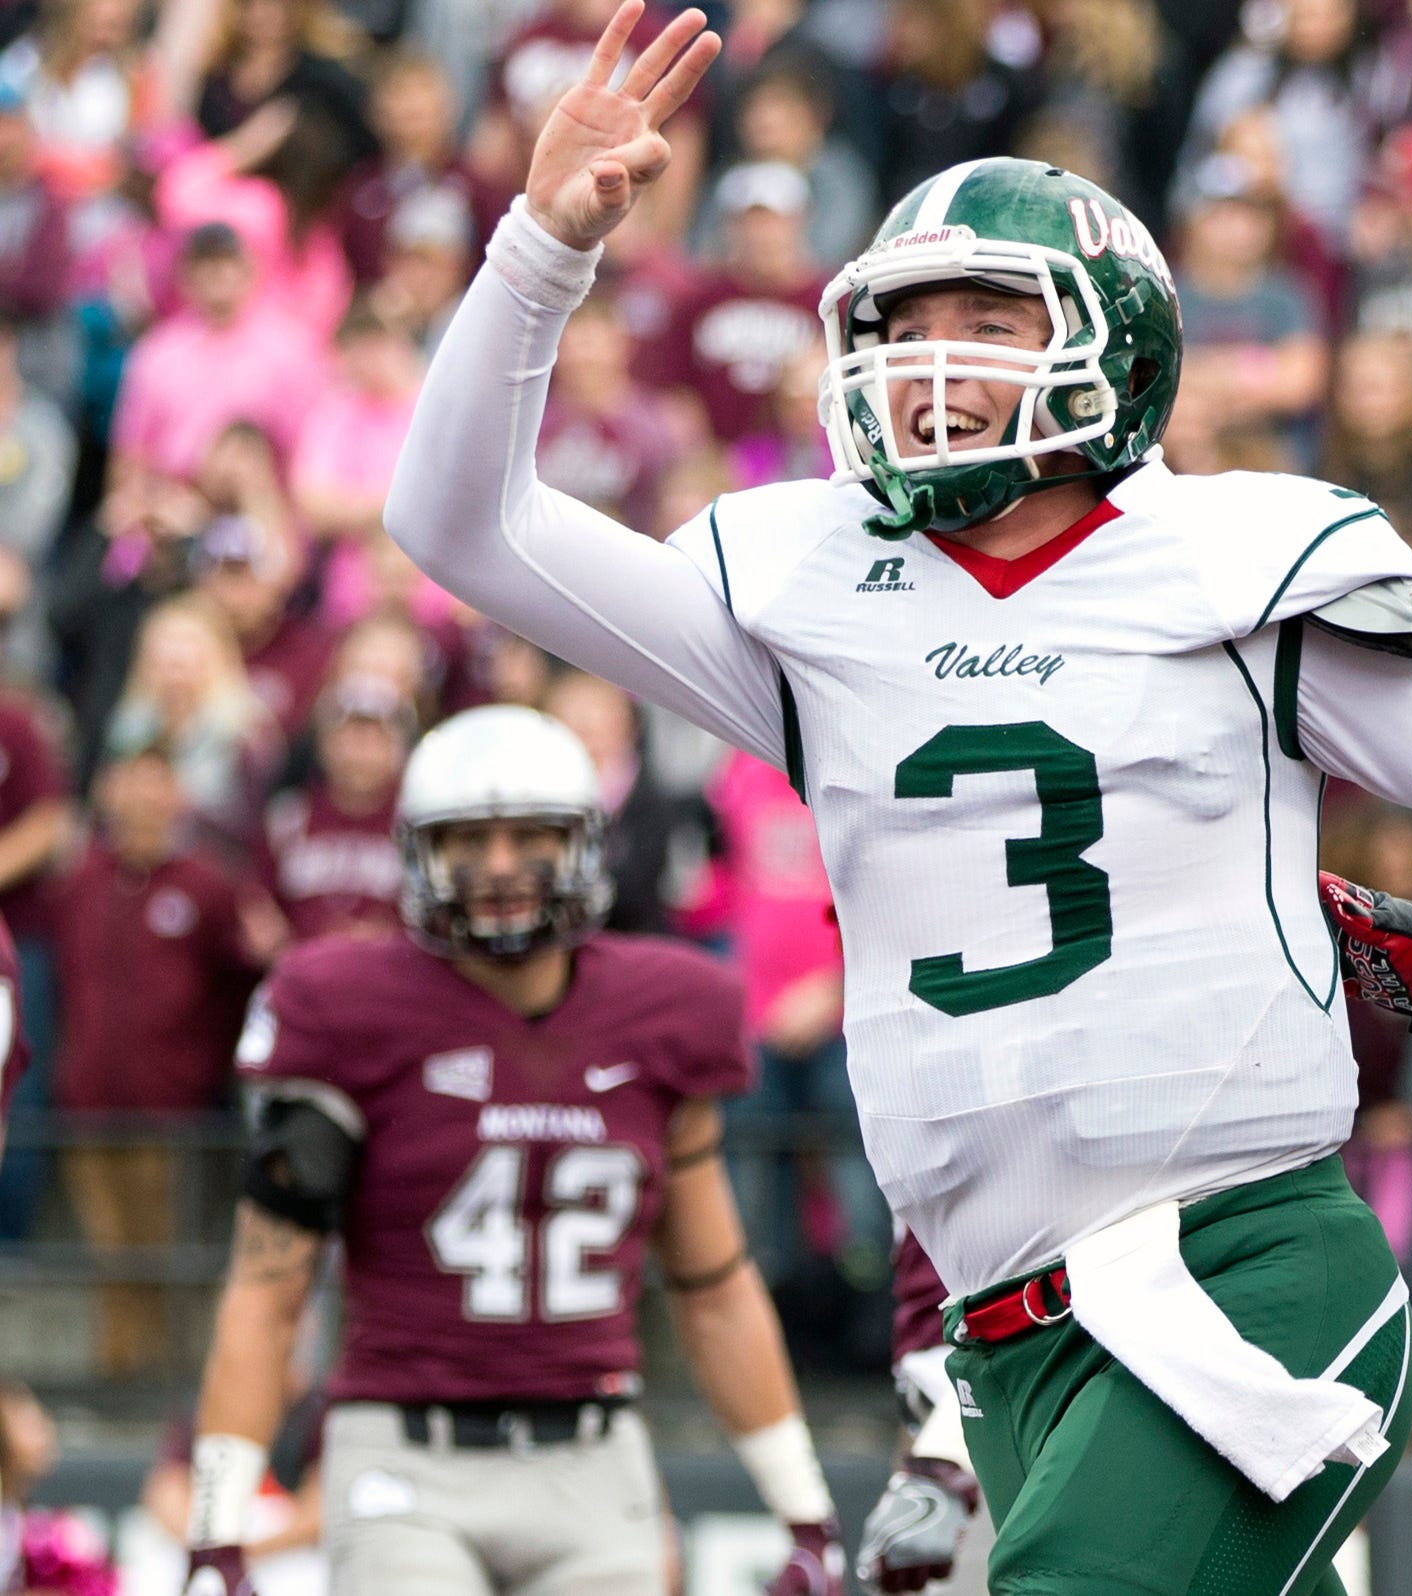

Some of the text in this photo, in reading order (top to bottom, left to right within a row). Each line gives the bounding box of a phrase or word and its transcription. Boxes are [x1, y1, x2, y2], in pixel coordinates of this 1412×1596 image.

[894, 228, 951, 248] Riddell
[855, 581, 916, 593] RUSSELL
[865, 557, 905, 582] R
[925, 641, 1065, 686] Valley
[894, 720, 1113, 1018] 3
[424, 1143, 646, 1324] 42
